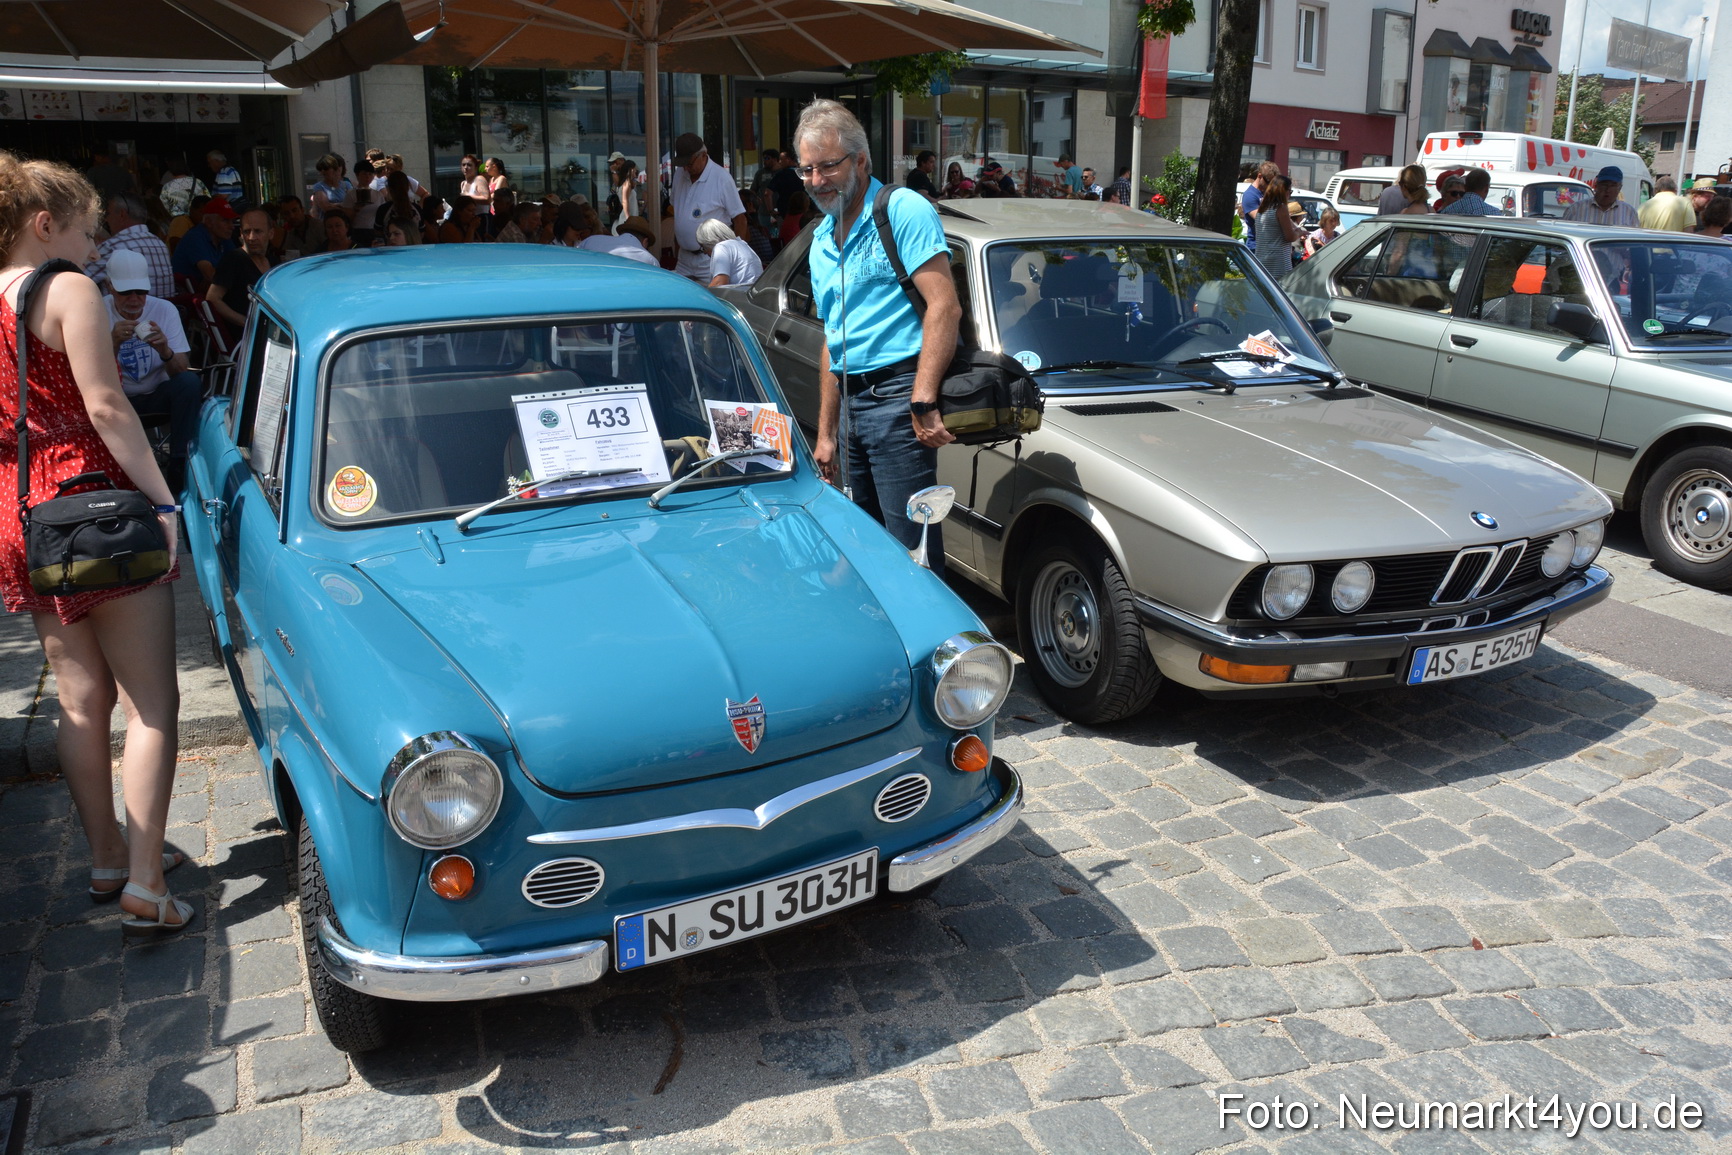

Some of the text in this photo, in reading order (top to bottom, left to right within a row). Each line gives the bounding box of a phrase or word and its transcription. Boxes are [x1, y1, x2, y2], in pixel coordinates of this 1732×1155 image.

[1513, 9, 1552, 36] RACKL
[1307, 119, 1340, 140] Achatz
[1022, 356, 1030, 364] H
[587, 406, 631, 429] 433
[88, 501, 116, 509] Canon
[1414, 629, 1538, 679] D AS E 525H
[626, 856, 874, 960] D N SU 303H
